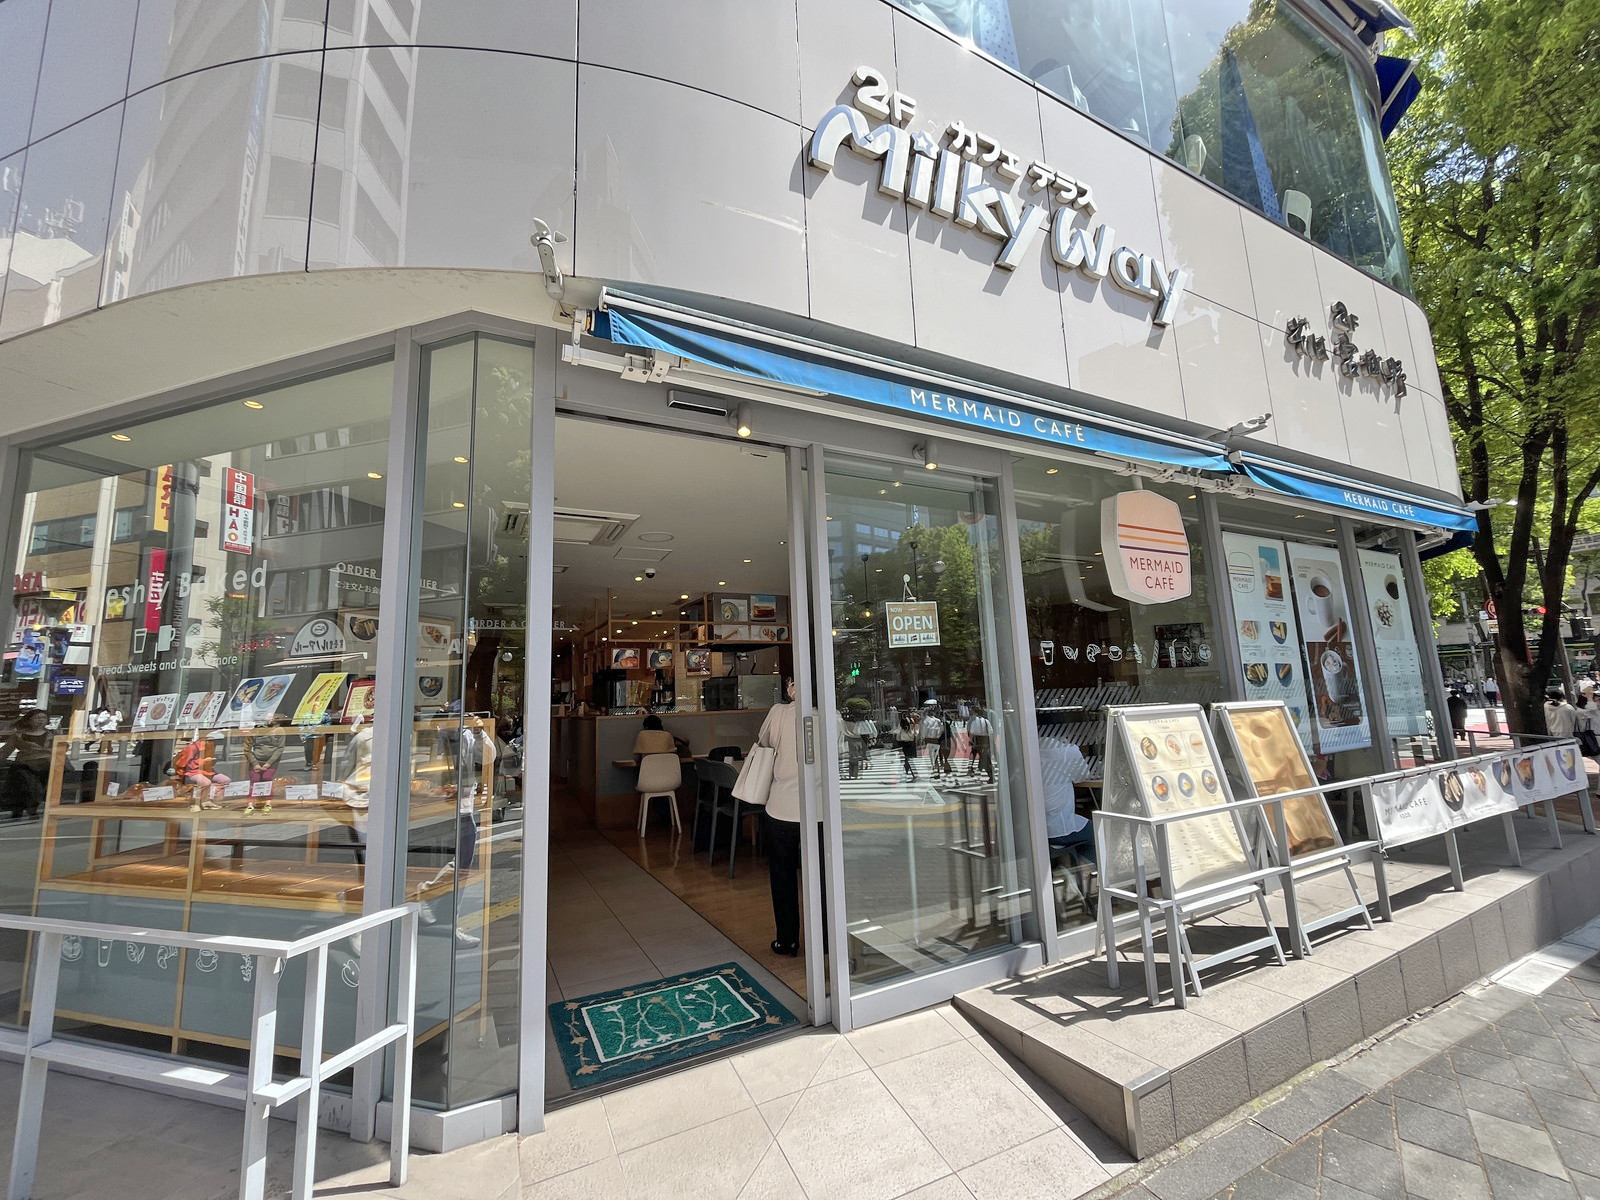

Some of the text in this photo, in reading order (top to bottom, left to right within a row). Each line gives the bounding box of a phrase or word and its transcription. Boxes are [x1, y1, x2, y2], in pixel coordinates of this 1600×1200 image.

[852, 64, 917, 124] 2F
[808, 103, 1188, 327] Milky Way
[910, 388, 1085, 442] MERMAID CAFÉ
[1343, 491, 1389, 511] MERMAID
[336, 562, 377, 579] ORDER
[1129, 556, 1184, 574] MERMAID
[1144, 575, 1175, 590] CAFÉ
[892, 615, 933, 631] OPEN
[127, 662, 157, 674] Sweets
[159, 659, 177, 671] and
